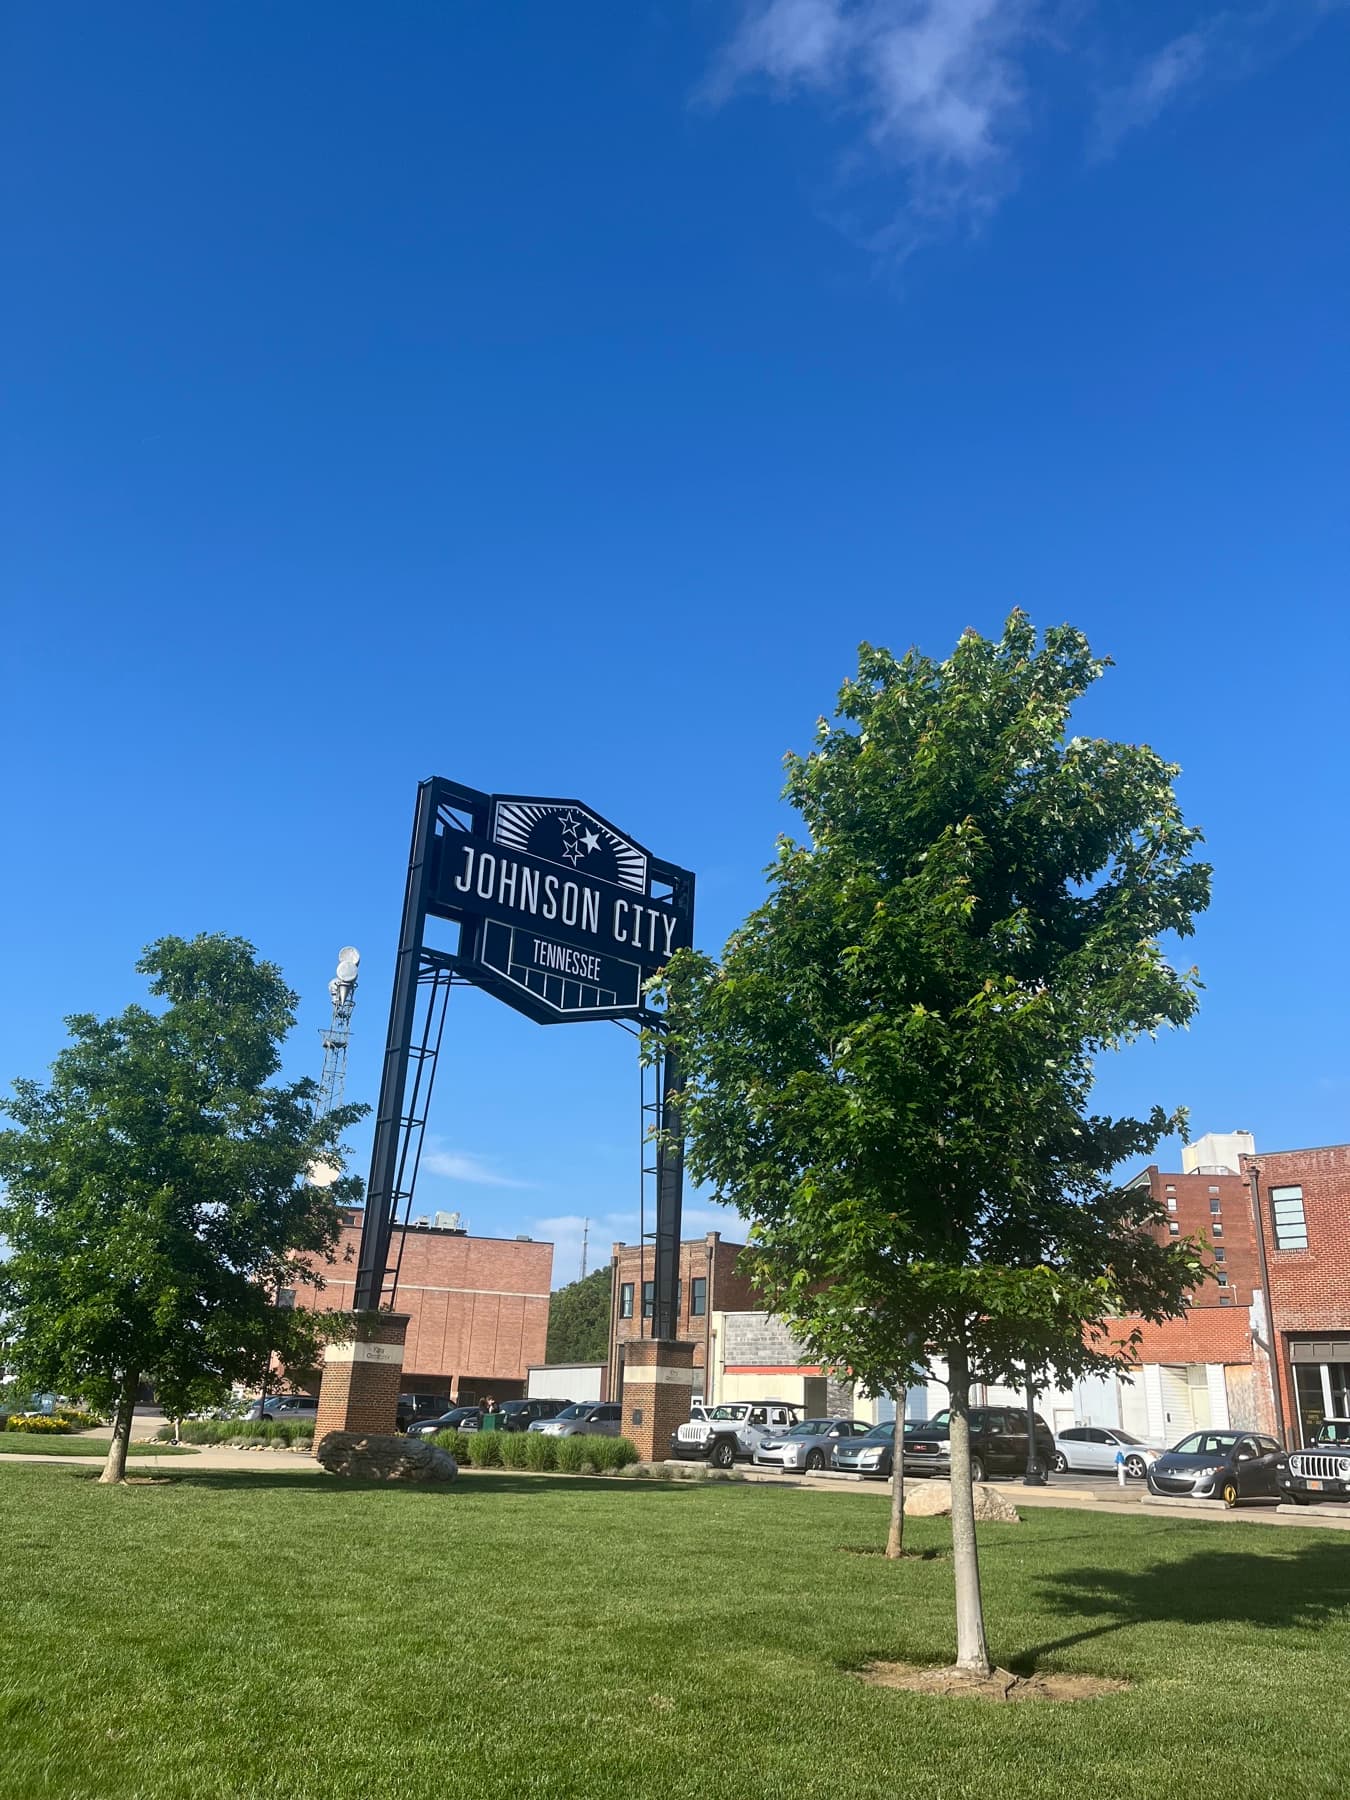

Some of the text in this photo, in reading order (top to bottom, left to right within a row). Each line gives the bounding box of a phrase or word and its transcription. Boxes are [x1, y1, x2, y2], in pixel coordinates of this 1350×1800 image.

[454, 845, 678, 958] JOHNSON CITY
[533, 938, 601, 982] TENNESSEE
